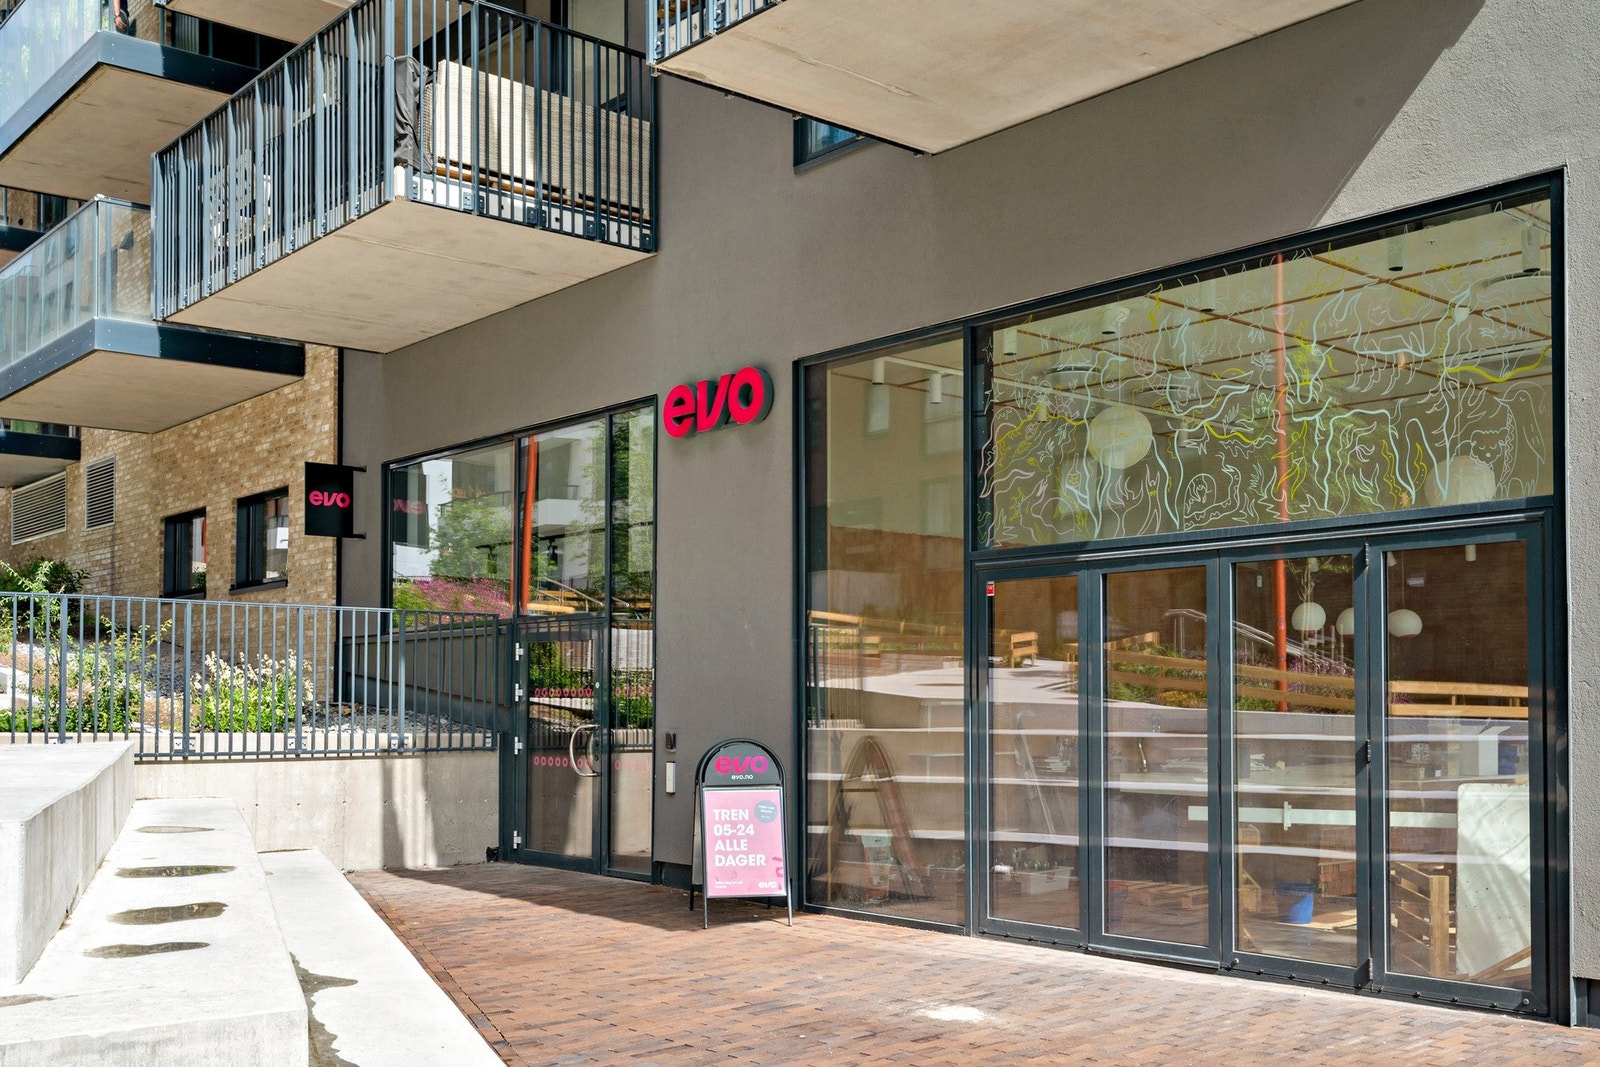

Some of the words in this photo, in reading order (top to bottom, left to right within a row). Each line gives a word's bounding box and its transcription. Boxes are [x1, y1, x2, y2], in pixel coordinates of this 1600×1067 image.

[663, 366, 766, 439] evo
[309, 490, 351, 508] evo
[714, 755, 769, 775] evo
[713, 808, 749, 821] TREN
[713, 823, 755, 836] 05-24
[714, 839, 748, 851] ALLE
[715, 854, 766, 867] DAGER
[758, 881, 777, 889] evo
